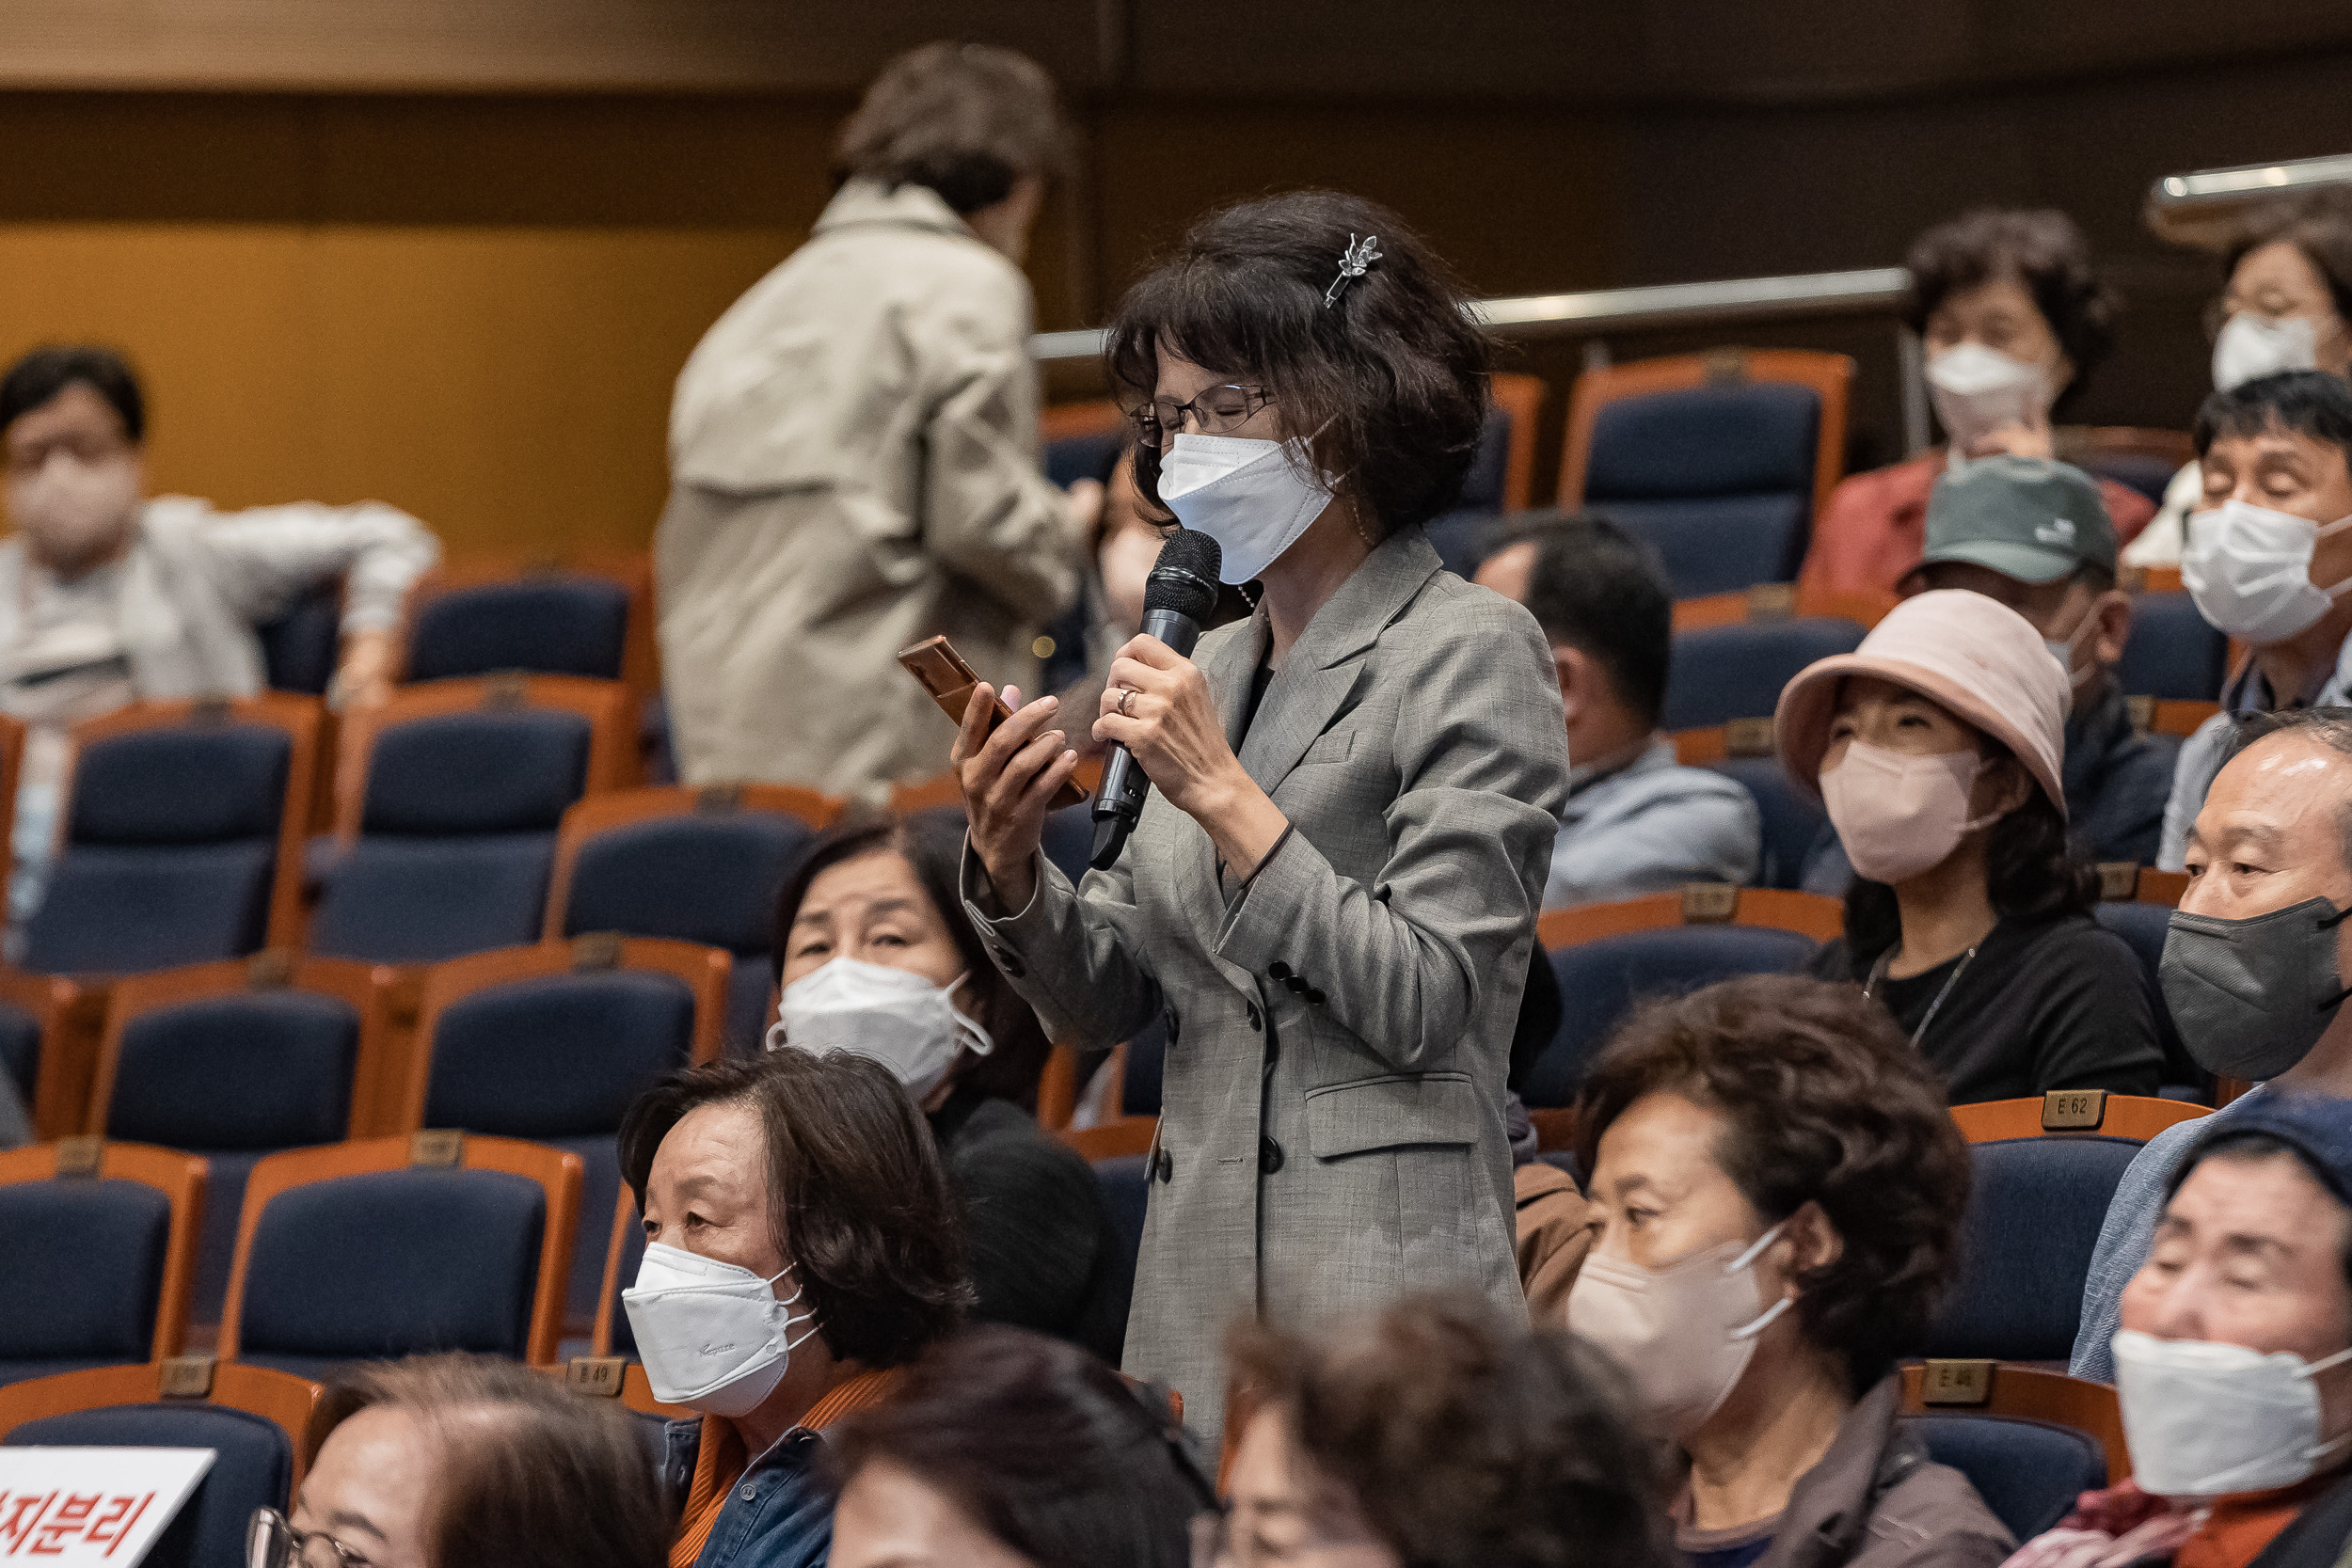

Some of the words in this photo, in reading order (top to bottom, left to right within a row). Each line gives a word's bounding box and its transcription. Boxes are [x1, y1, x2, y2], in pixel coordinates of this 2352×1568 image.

[2058, 1097, 2067, 1115] E
[2071, 1096, 2088, 1115] 62
[592, 1365, 608, 1384] 49
